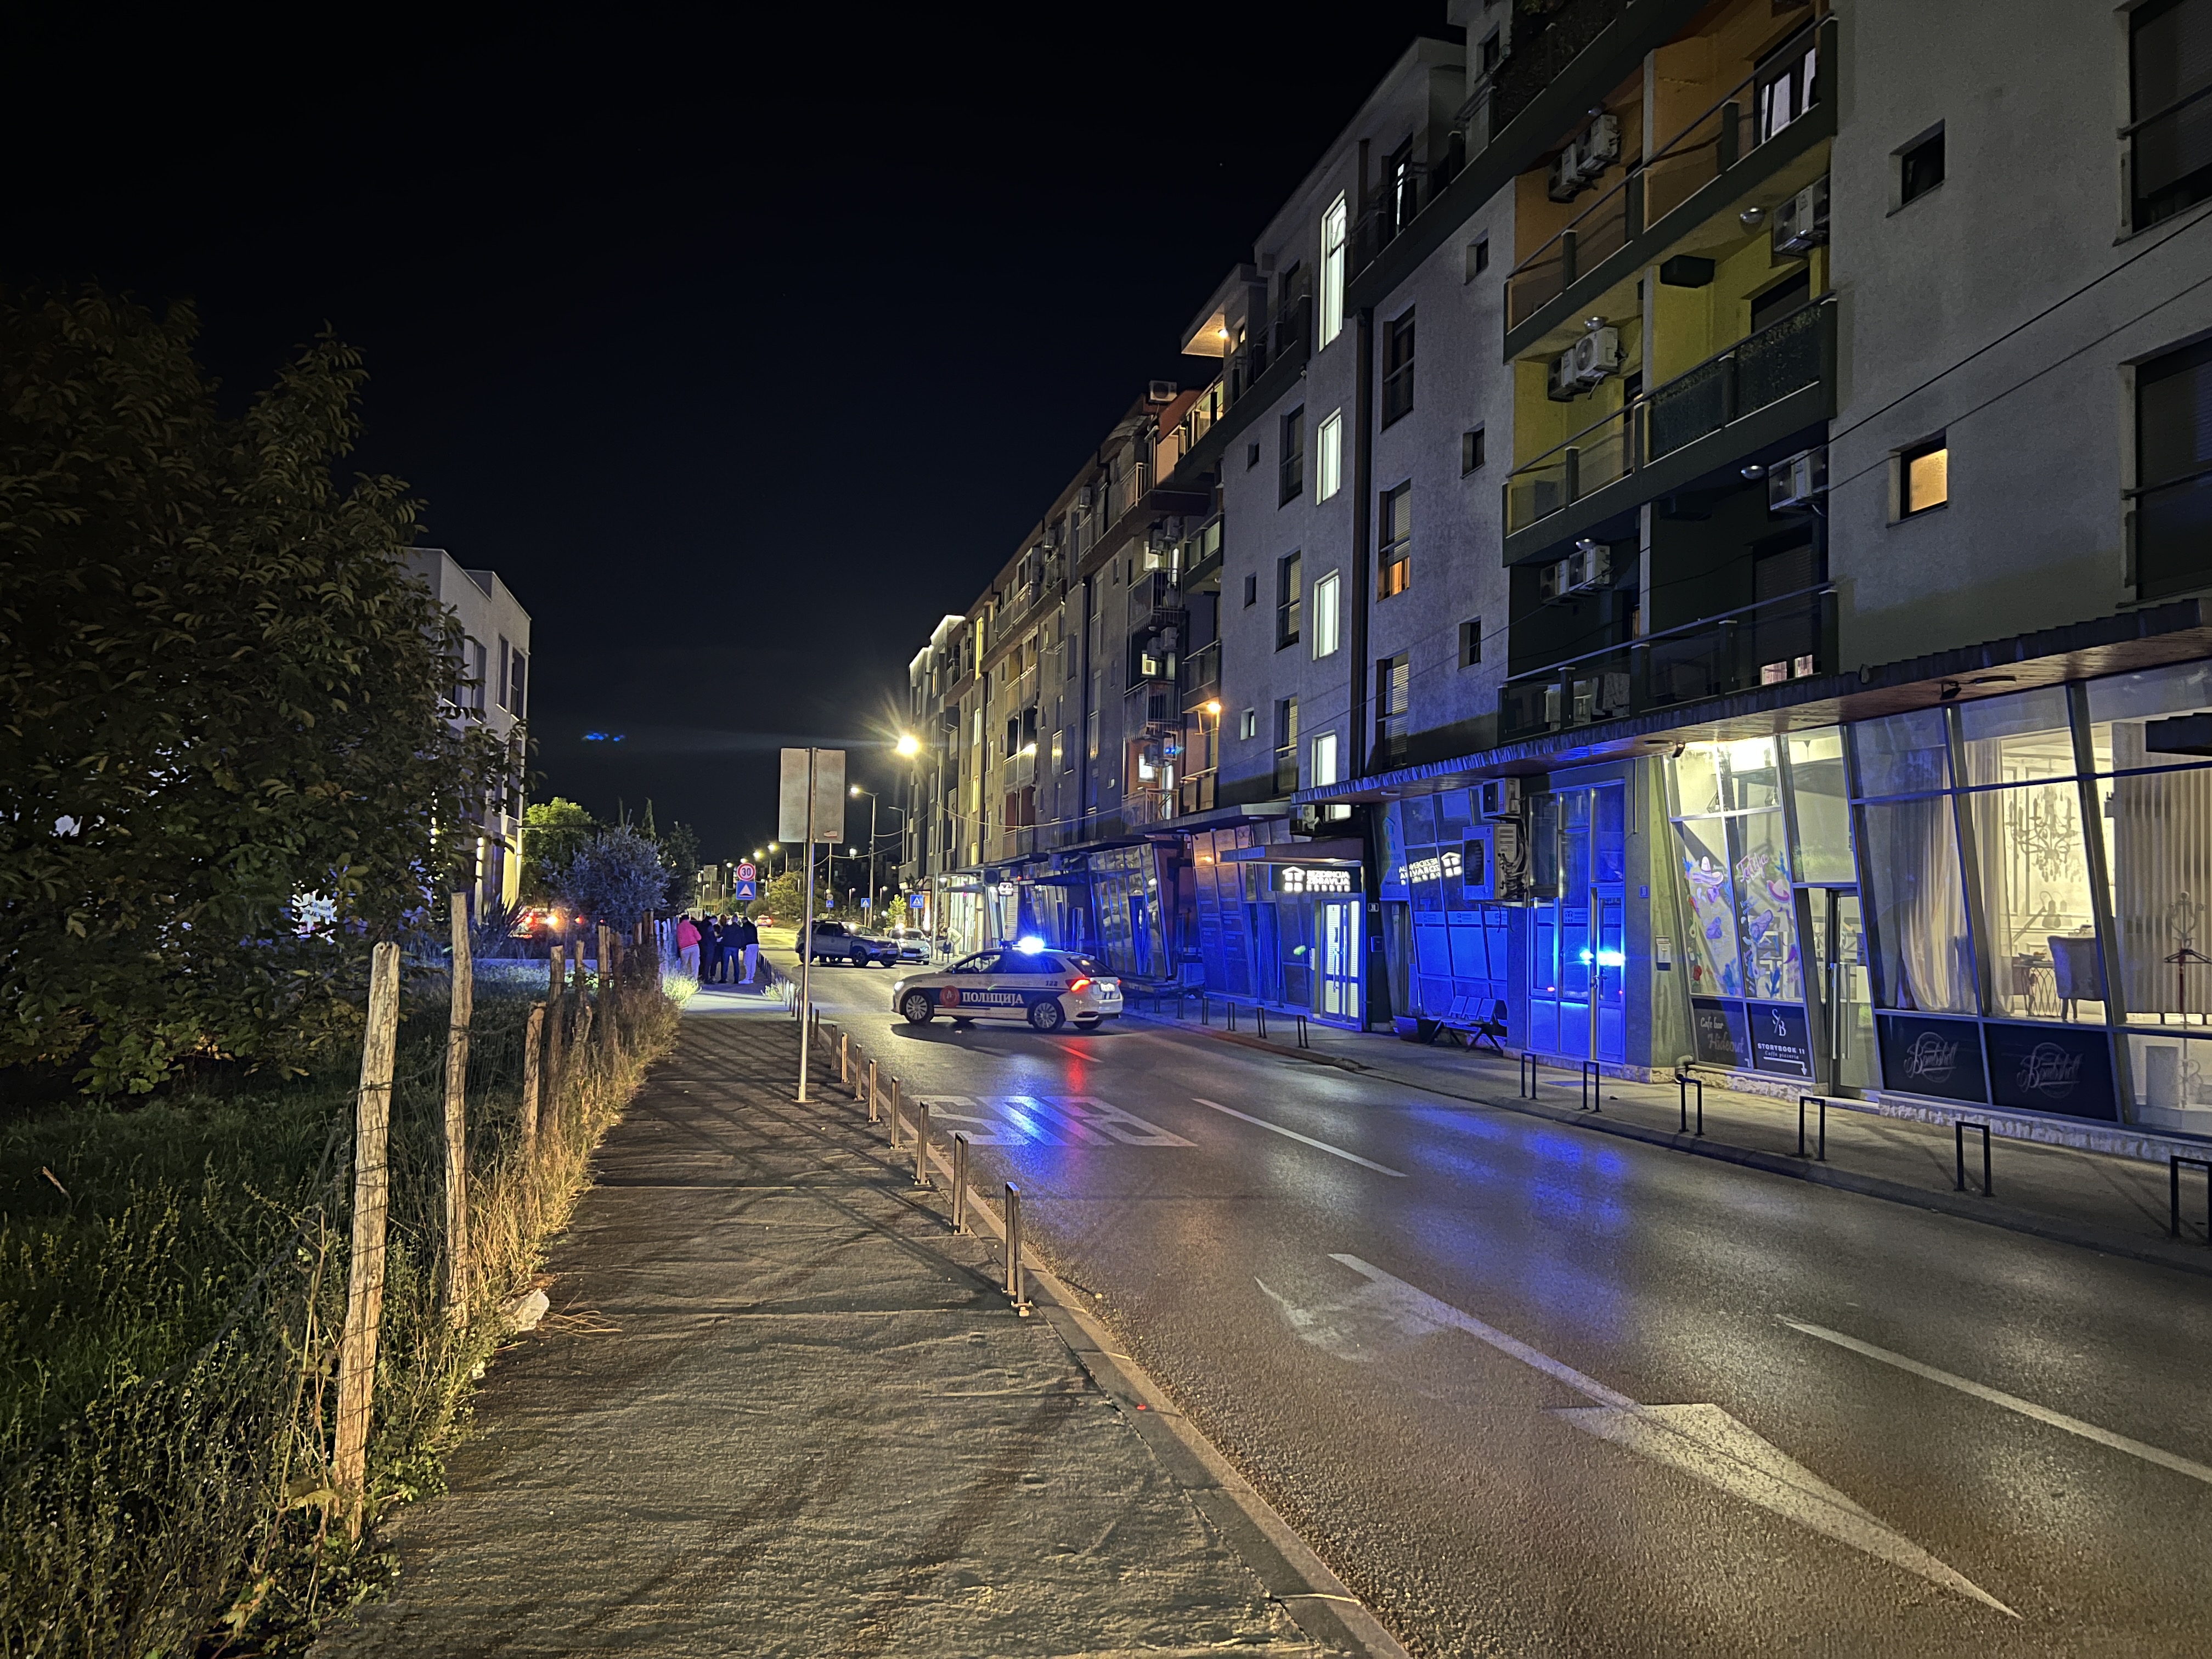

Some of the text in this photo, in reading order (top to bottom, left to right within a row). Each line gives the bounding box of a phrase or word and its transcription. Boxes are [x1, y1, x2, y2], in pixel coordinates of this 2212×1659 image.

[742, 868, 751, 876] 30
[962, 992, 1024, 1006] ПОЛИЦИЈА
[1707, 1031, 1744, 1053] Hideout
[1757, 1043, 1797, 1053] STORYBOOK
